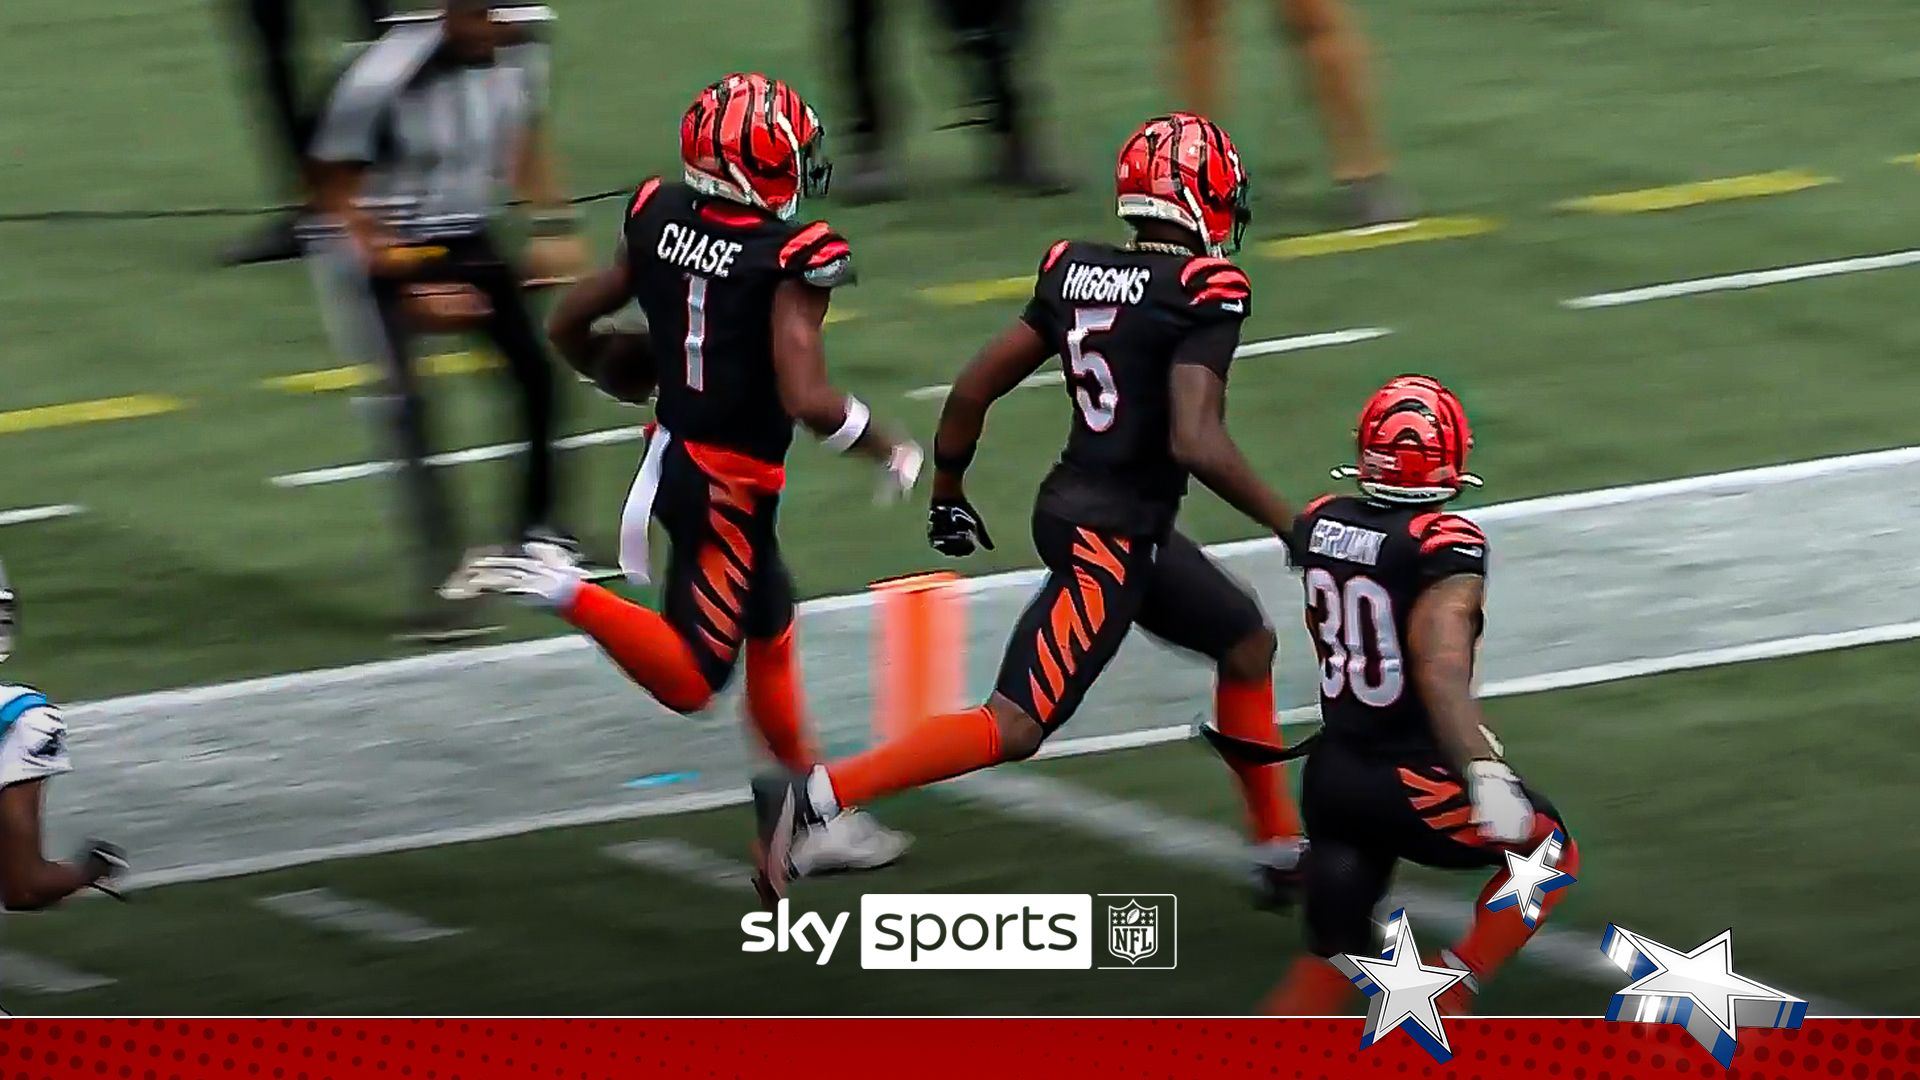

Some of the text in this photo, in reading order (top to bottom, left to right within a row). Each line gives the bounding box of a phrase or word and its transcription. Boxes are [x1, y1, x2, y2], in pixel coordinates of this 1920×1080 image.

[657, 223, 743, 278] CHASE
[1062, 263, 1150, 305] HIGGINS
[684, 275, 709, 392] 1
[1067, 306, 1119, 432] 5
[1306, 567, 1402, 707] 30
